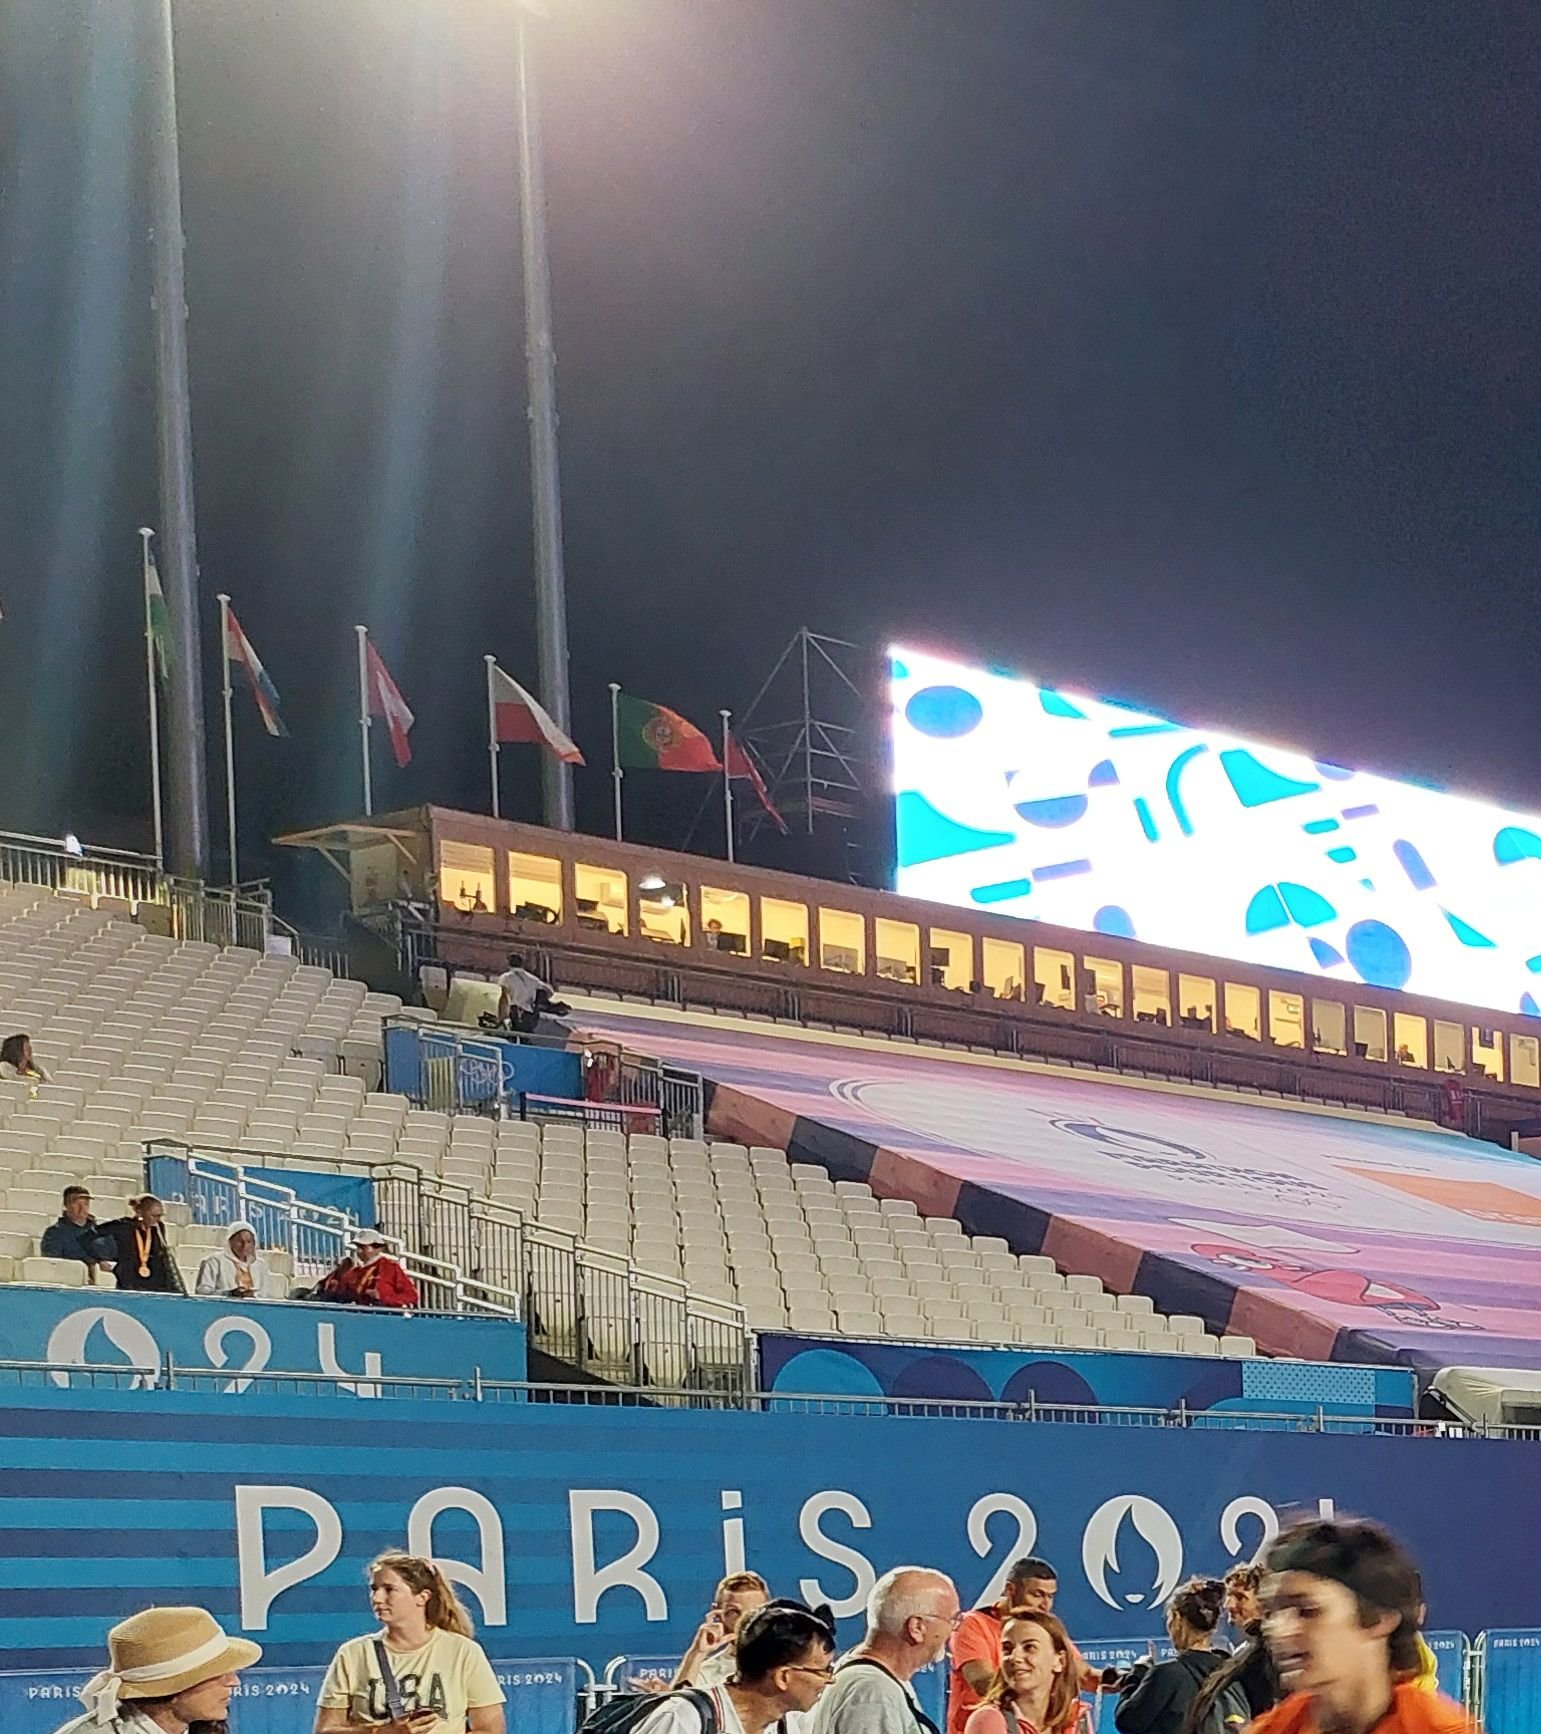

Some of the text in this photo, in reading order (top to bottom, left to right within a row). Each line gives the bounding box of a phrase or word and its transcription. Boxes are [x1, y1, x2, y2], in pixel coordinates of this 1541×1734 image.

[966, 1491, 1335, 1613] 202
[524, 1673, 563, 1685] 2024
[265, 1684, 310, 1697] 2024
